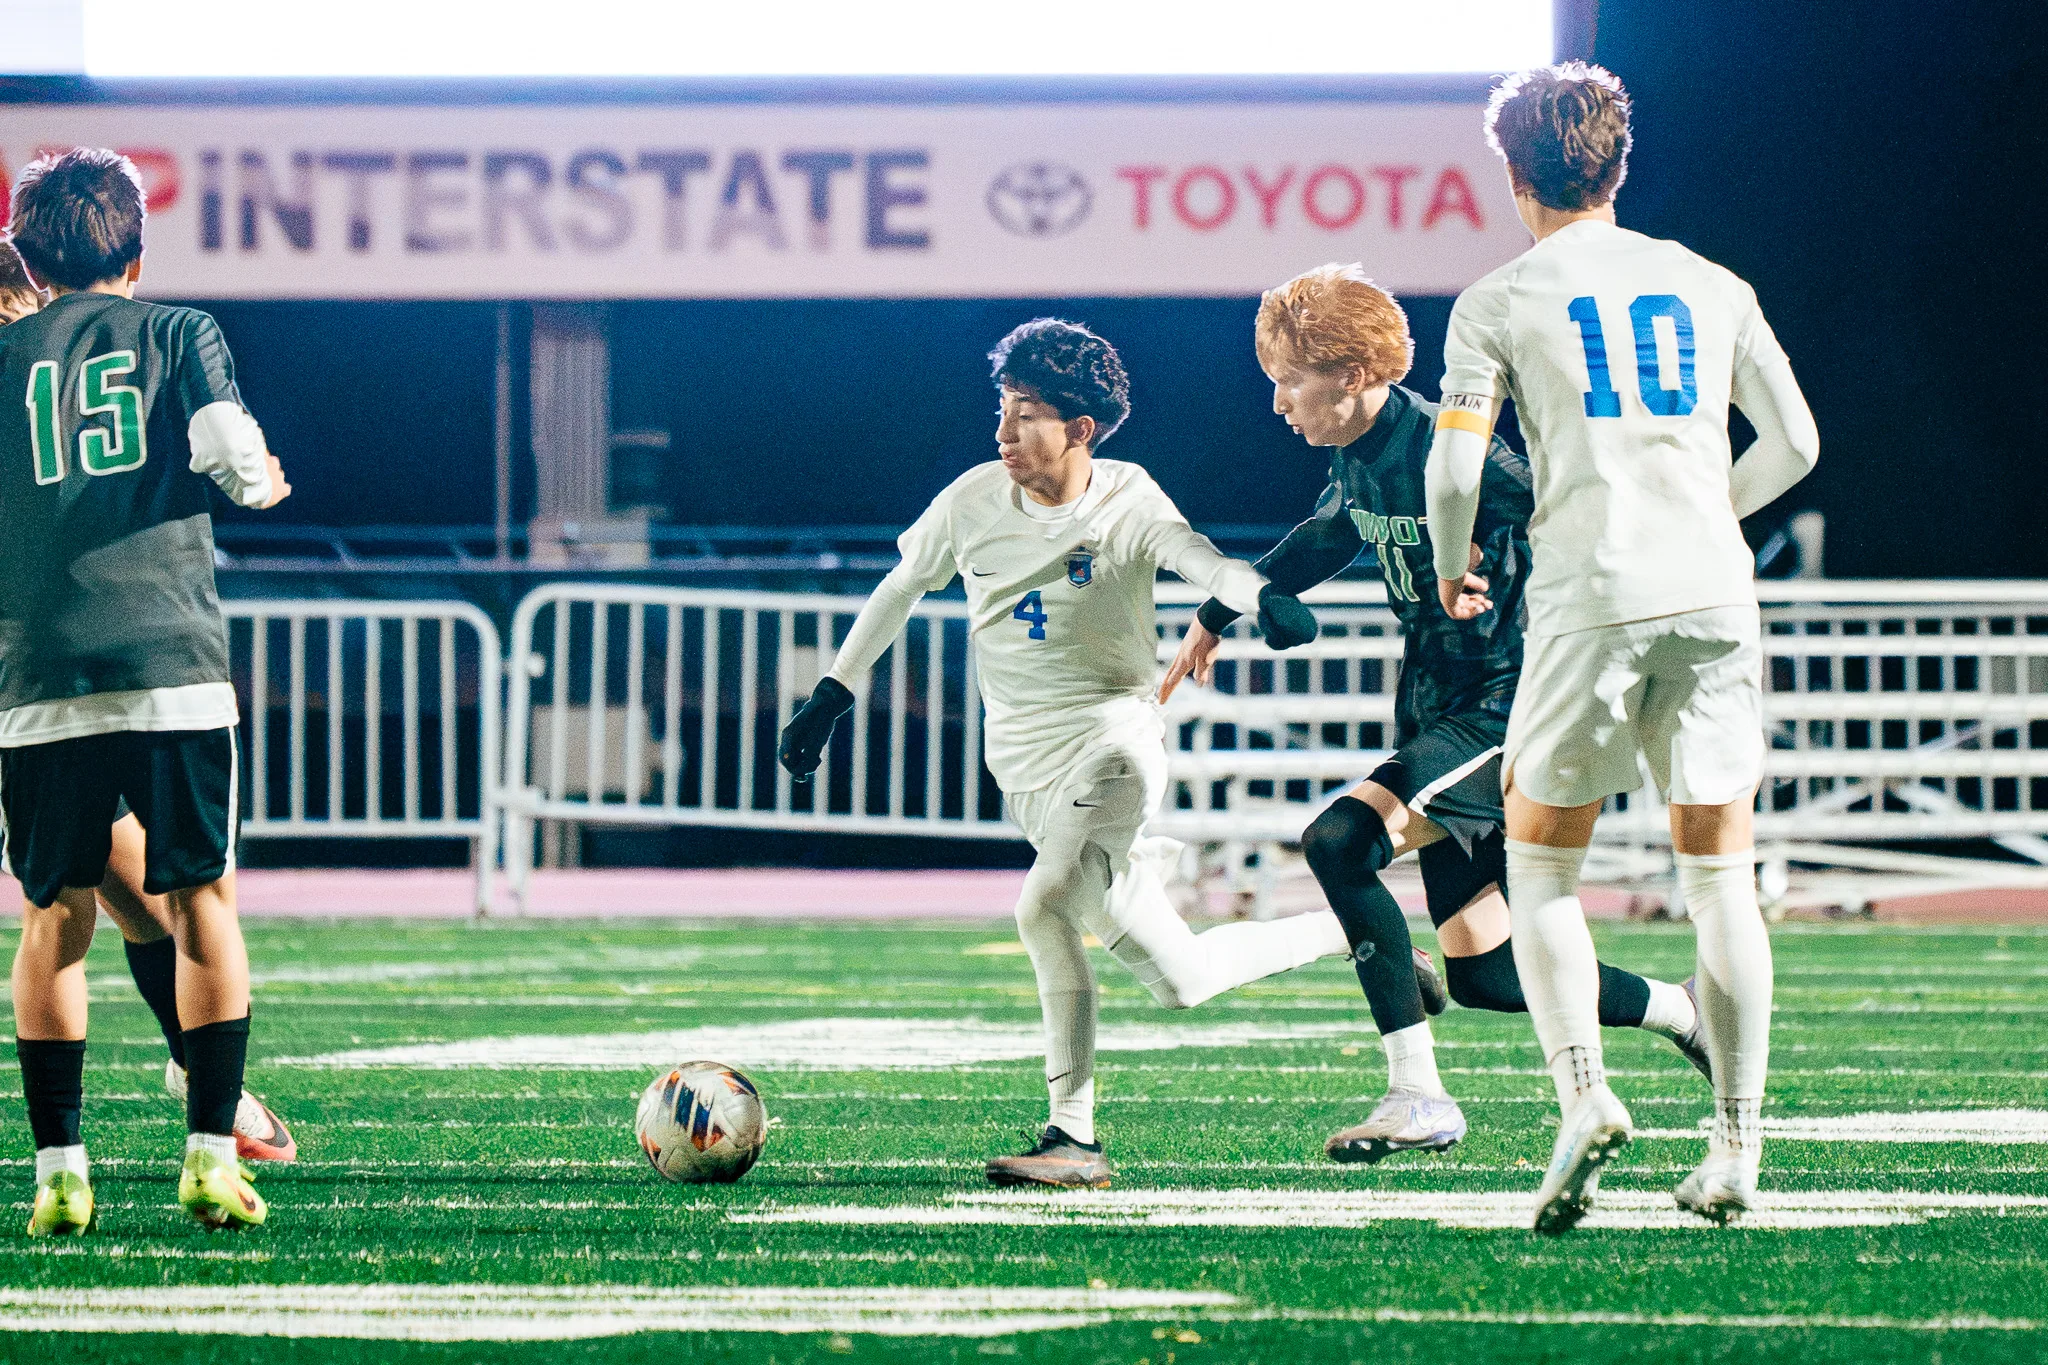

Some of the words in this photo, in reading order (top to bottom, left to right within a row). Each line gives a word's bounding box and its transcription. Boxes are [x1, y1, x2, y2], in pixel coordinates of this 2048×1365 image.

[200, 147, 931, 252] INTERSTATE
[1115, 163, 1484, 231] TOYOTA
[1567, 294, 1698, 418] 10
[26, 350, 147, 486] 15
[1013, 590, 1048, 641] 4
